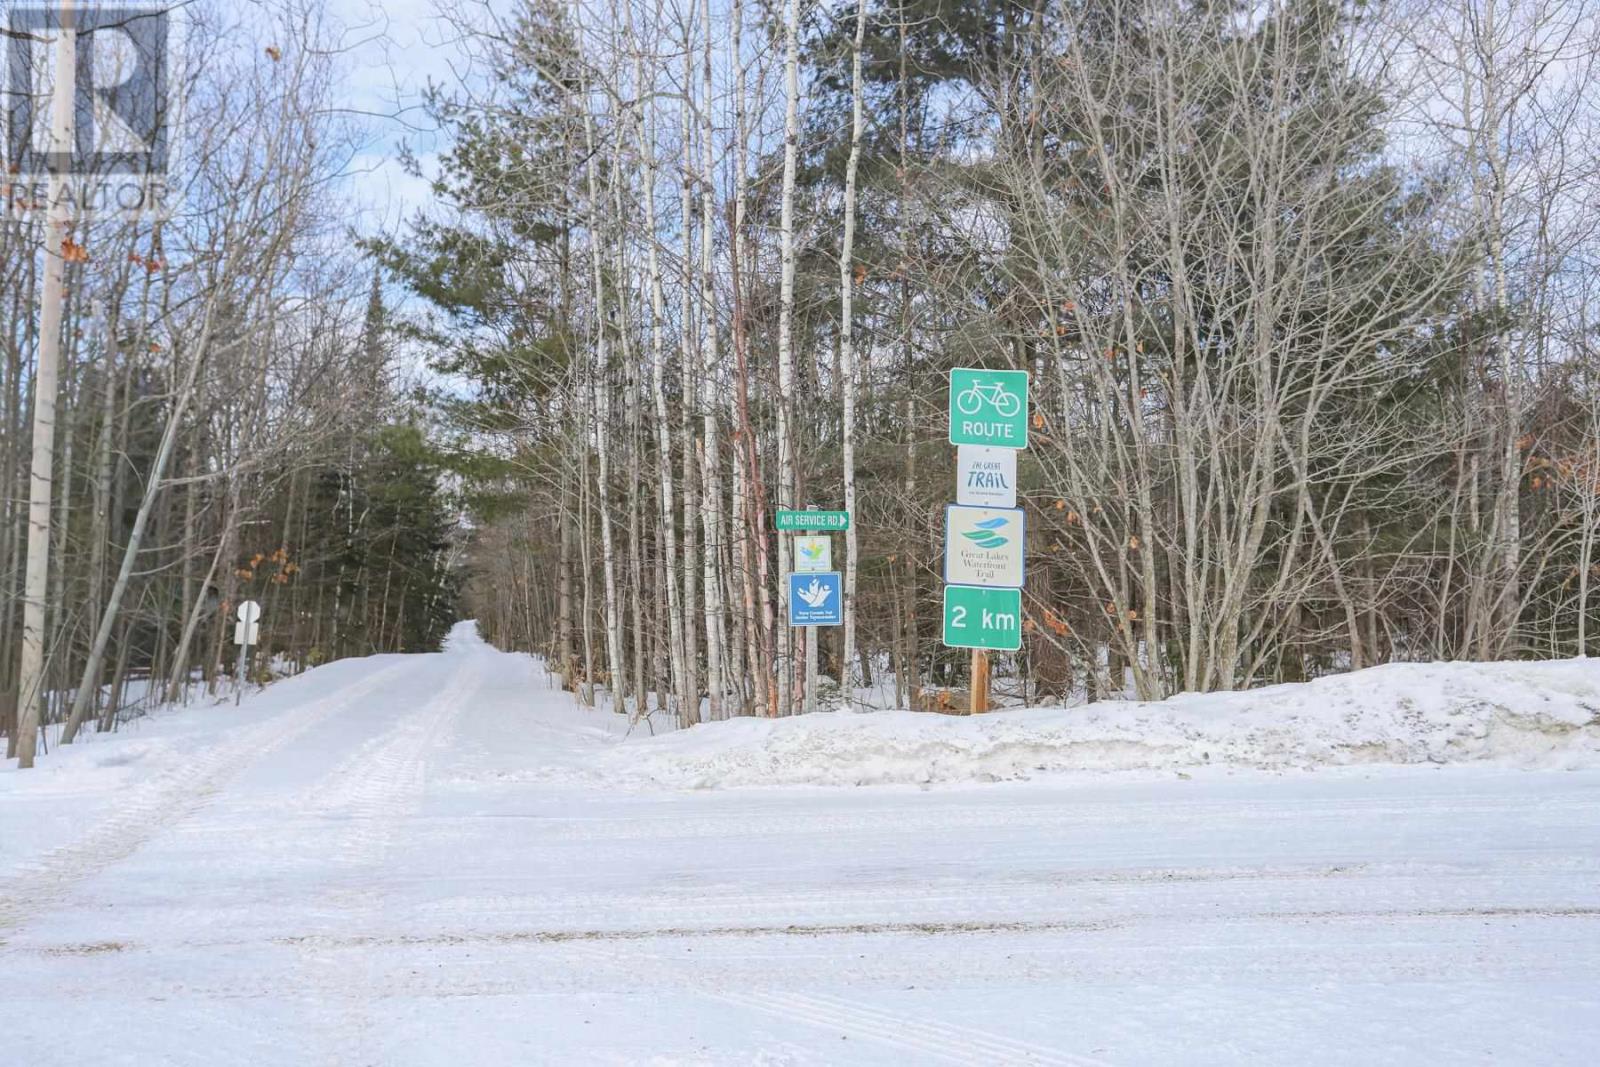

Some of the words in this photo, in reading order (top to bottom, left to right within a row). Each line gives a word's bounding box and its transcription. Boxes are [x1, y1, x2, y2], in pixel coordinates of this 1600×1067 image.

[962, 421, 1014, 438] ROUTE
[781, 514, 793, 526] AIR
[795, 514, 825, 526] SERVICE
[961, 550, 983, 558] Great
[986, 551, 1008, 560] Lakes
[963, 559, 1006, 570] Waterfront
[976, 569, 994, 578] Trail
[951, 605, 967, 628] 2
[982, 608, 1015, 630] km
